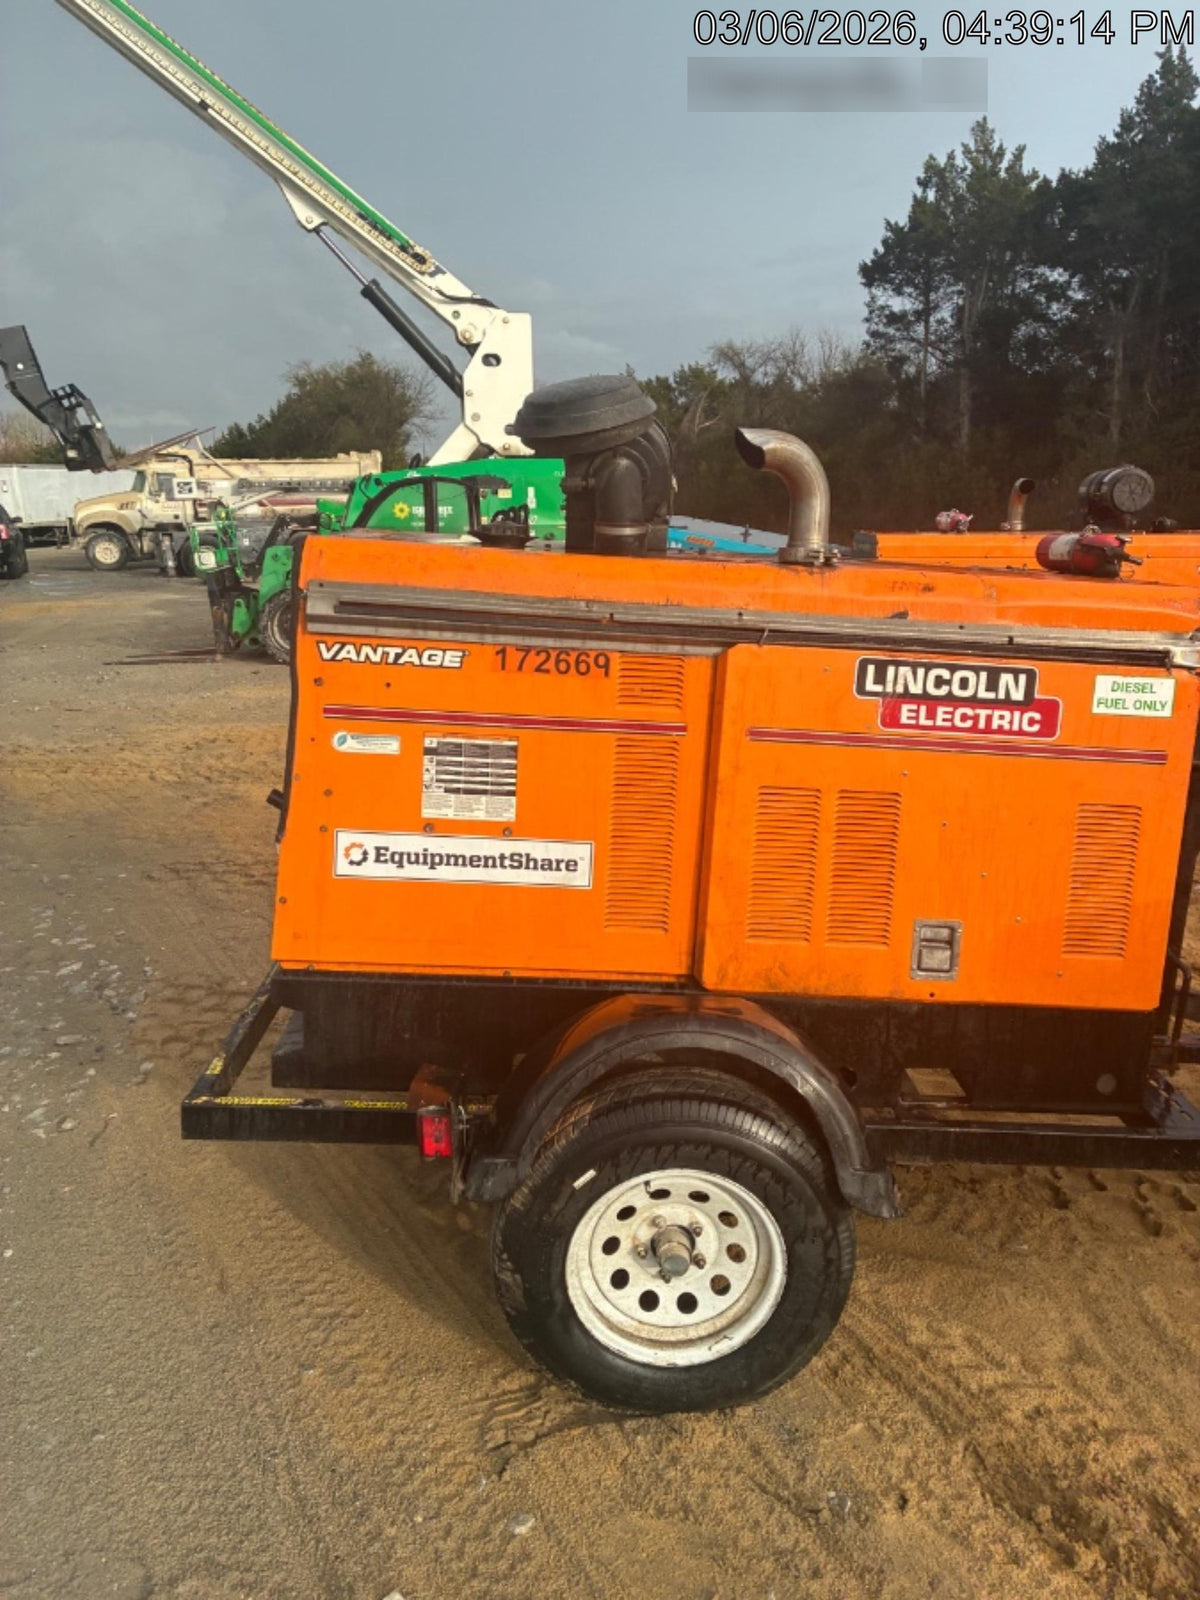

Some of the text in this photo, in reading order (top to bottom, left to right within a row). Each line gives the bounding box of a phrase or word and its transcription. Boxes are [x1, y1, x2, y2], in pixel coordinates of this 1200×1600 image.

[316, 642, 464, 669] VANTAGE
[495, 647, 611, 678] 172669
[864, 664, 1027, 701] LINCOLN
[1111, 681, 1157, 694] DIESEL
[1096, 697, 1169, 711] FUEL ONLY
[900, 703, 1042, 733] ELECTRIC
[373, 846, 579, 872] EquipmentShare
